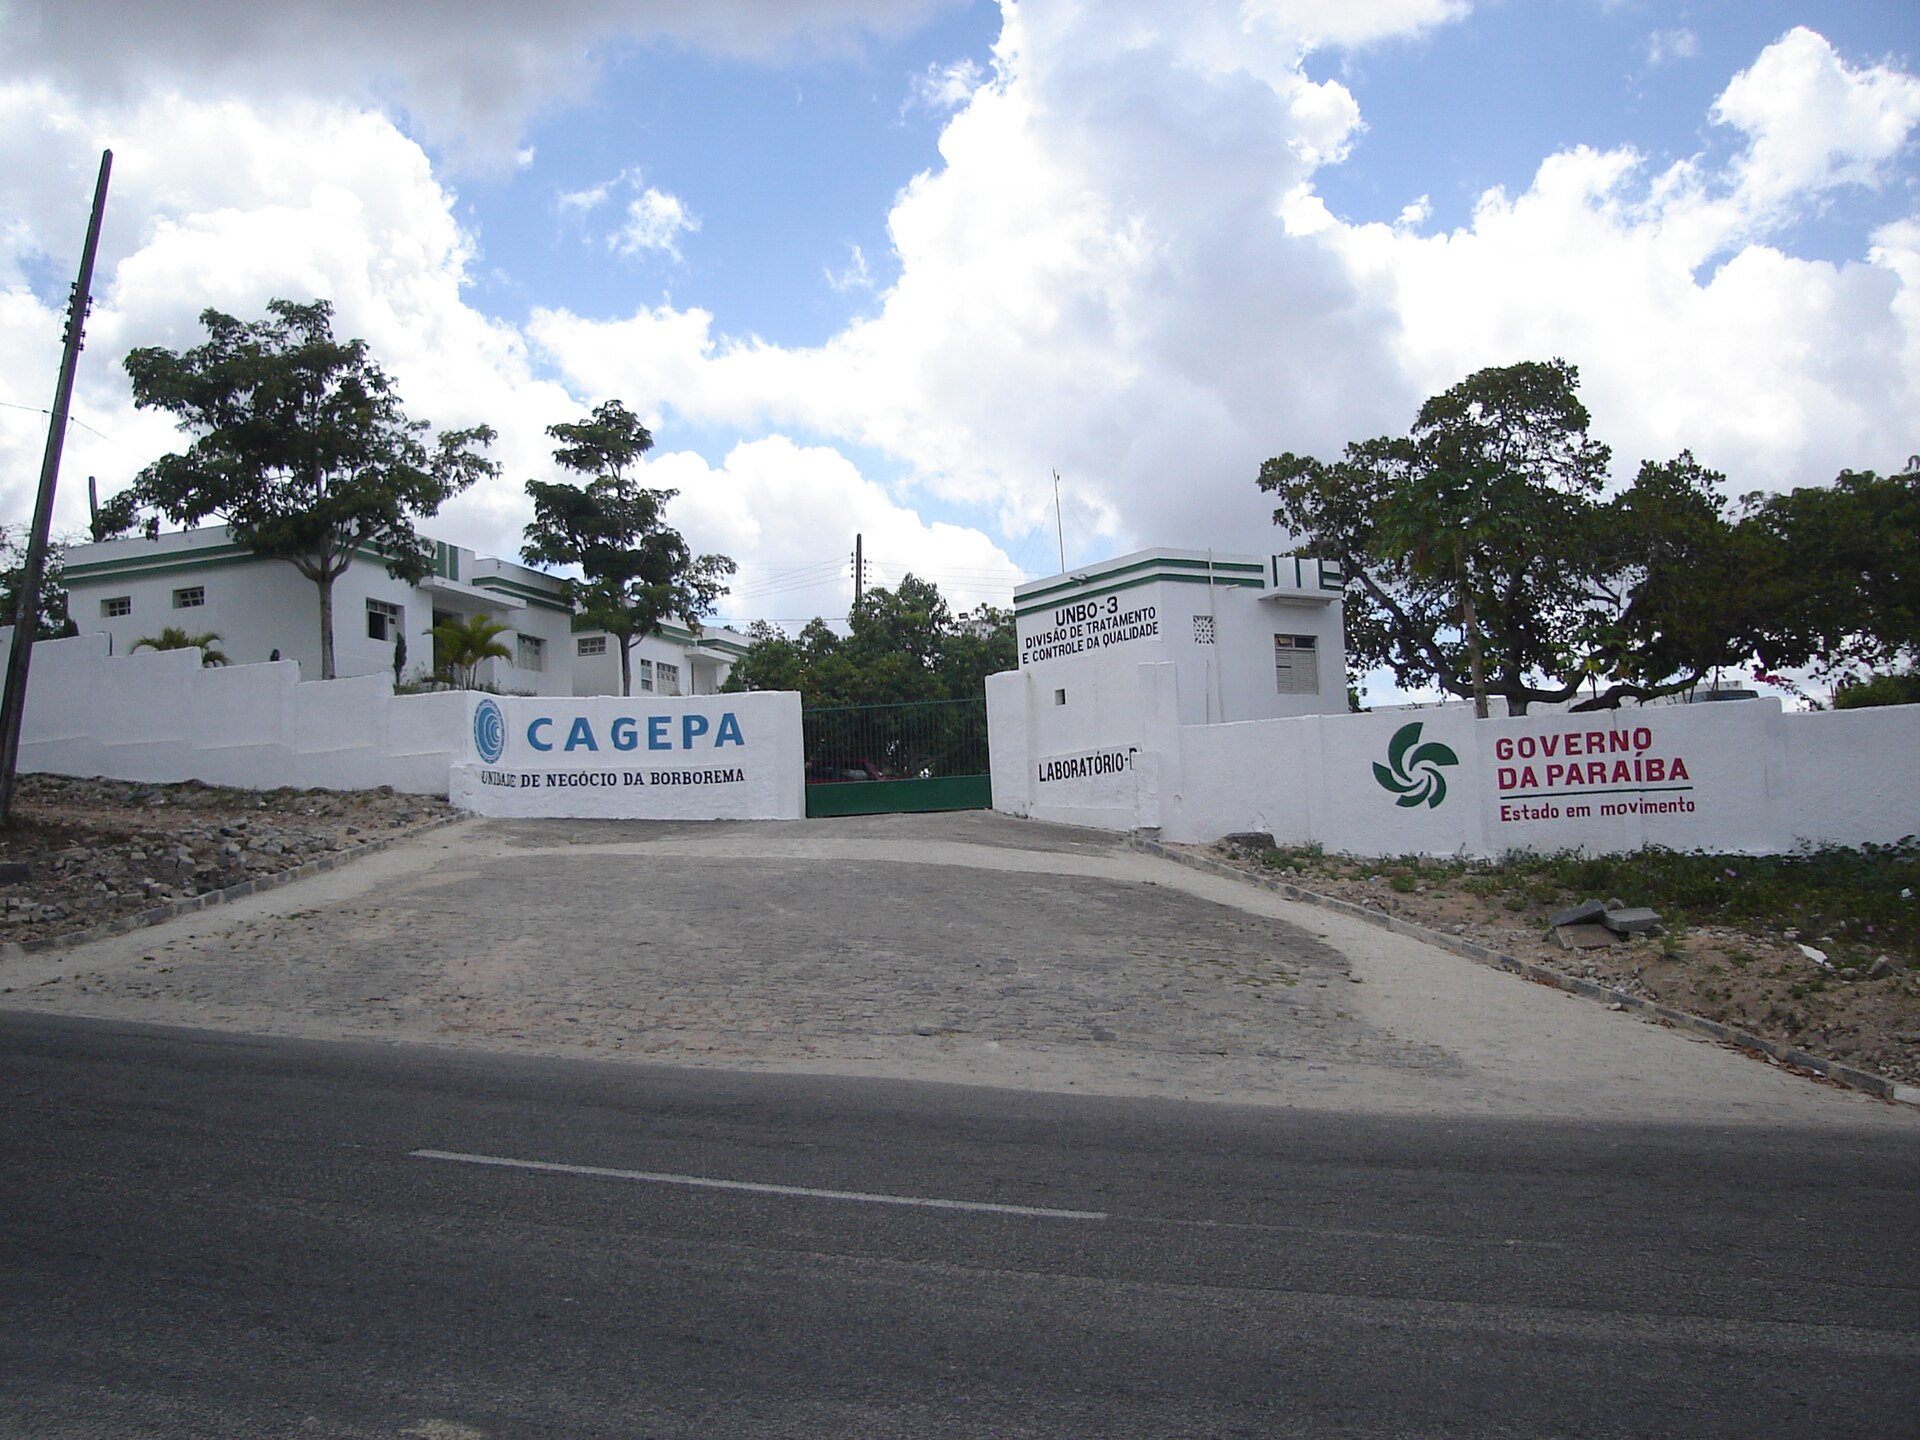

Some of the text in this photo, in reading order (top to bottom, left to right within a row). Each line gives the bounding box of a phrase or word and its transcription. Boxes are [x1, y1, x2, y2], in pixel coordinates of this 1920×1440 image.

[1069, 625, 1083, 639] DE
[1086, 606, 1156, 634] TRATAMENTO
[1022, 621, 1159, 664] E CONTROLE DA QUALIDADE
[527, 713, 745, 751] CAGEPA
[1495, 727, 1652, 760] GOVERNO
[521, 774, 541, 788] DE
[547, 770, 617, 787] NEGÓCIO
[623, 772, 646, 786] DA
[650, 768, 745, 785] BORBOREMA
[1498, 751, 1689, 790] DA PARAÍBA
[1500, 796, 1695, 821] Estado em movimento
